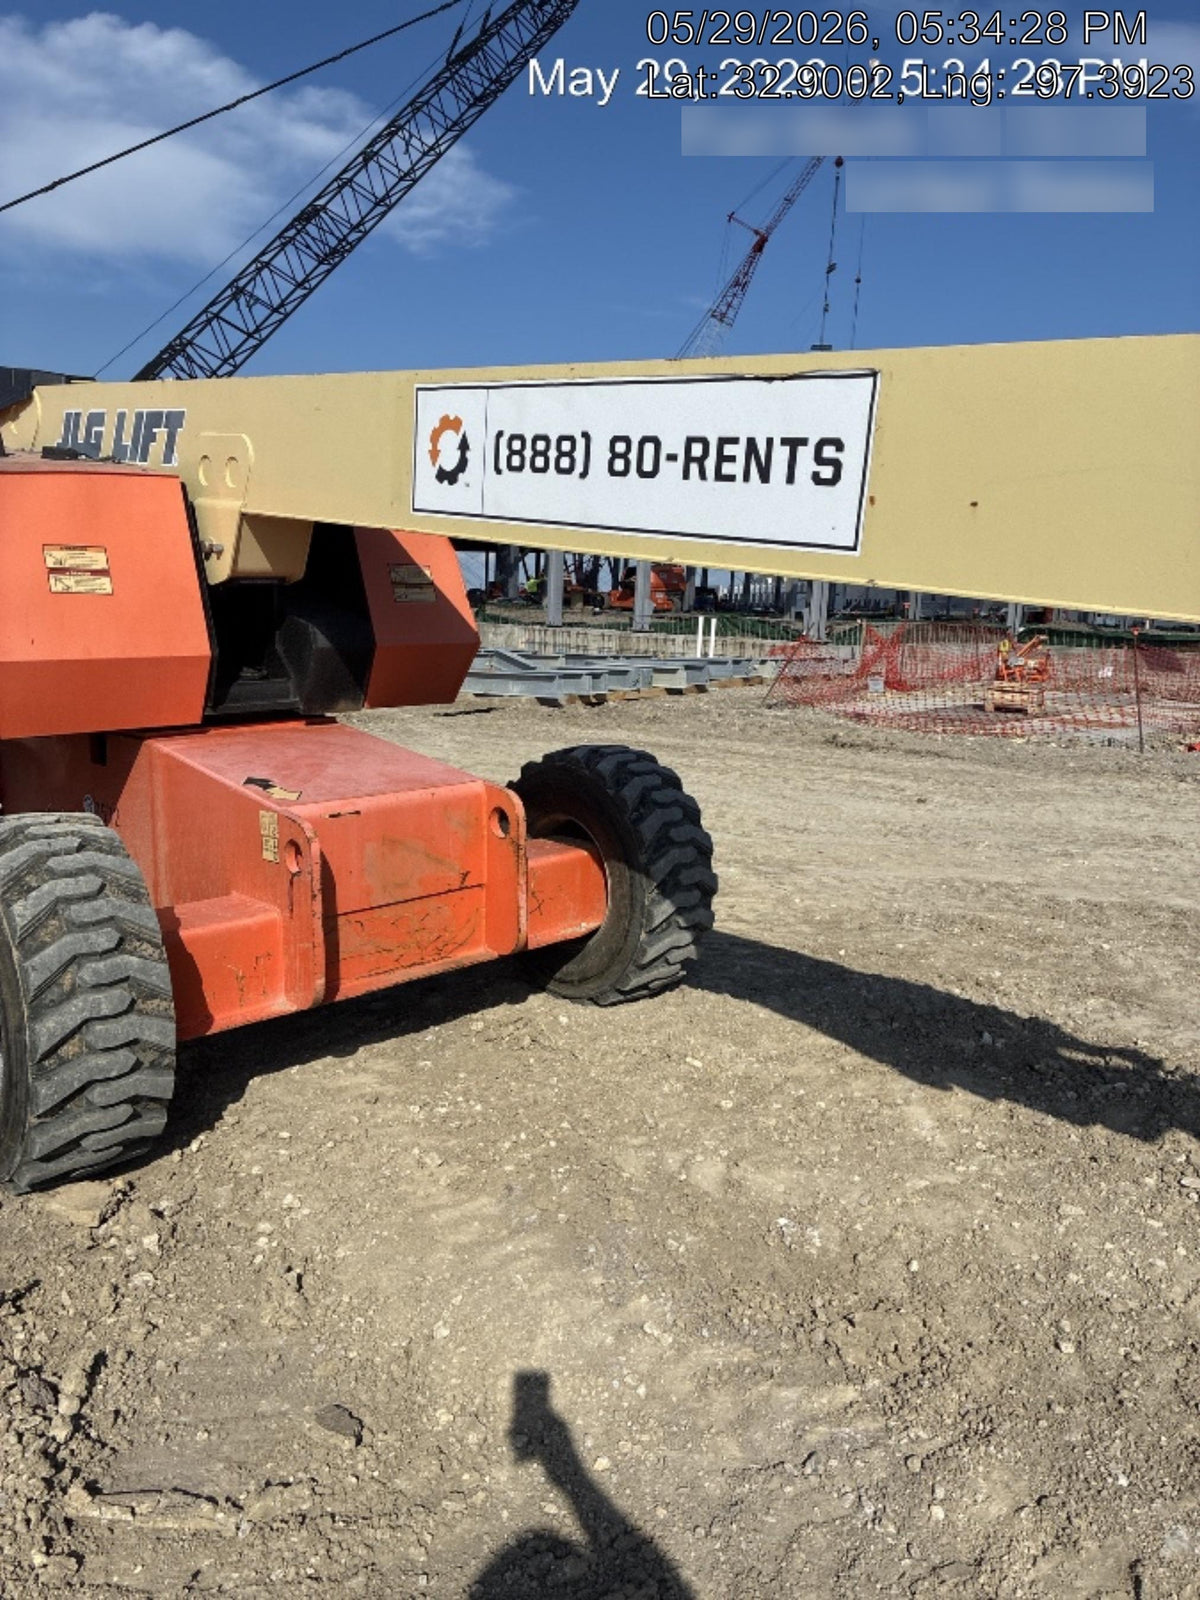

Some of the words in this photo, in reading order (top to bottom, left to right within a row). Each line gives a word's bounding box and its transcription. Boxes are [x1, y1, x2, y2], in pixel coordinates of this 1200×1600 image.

[56, 409, 107, 463] JLG
[111, 408, 187, 467] LIFT
[494, 430, 591, 480] (888)
[607, 434, 846, 487] 80-RENTS
